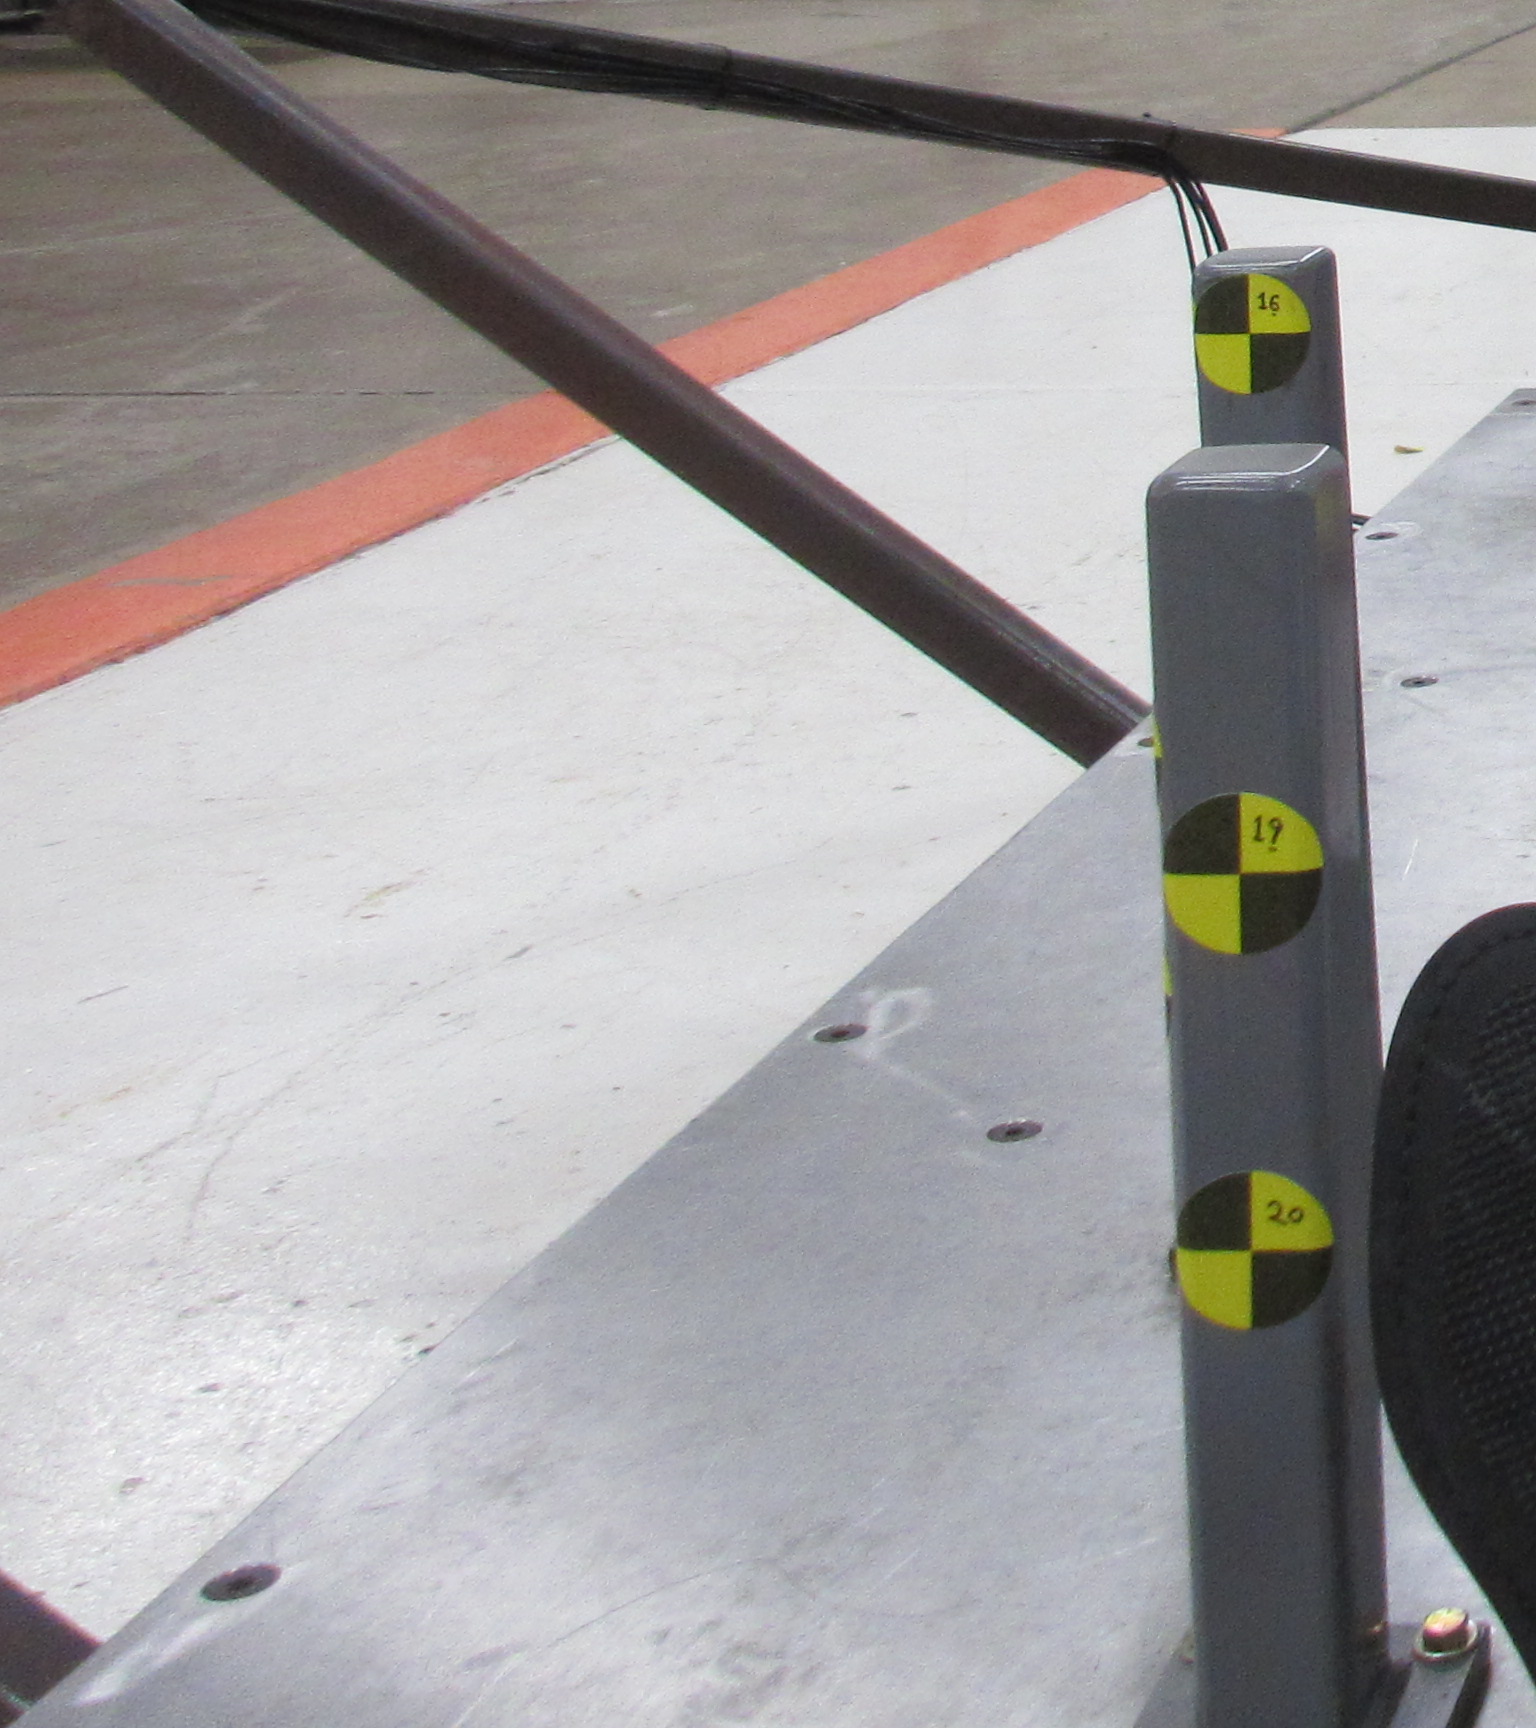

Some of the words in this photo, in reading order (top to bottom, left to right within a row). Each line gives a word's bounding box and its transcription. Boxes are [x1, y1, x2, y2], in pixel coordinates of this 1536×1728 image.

[1257, 292, 1280, 314] 16
[1253, 815, 1284, 848] 19
[1267, 1200, 1304, 1226] 20
